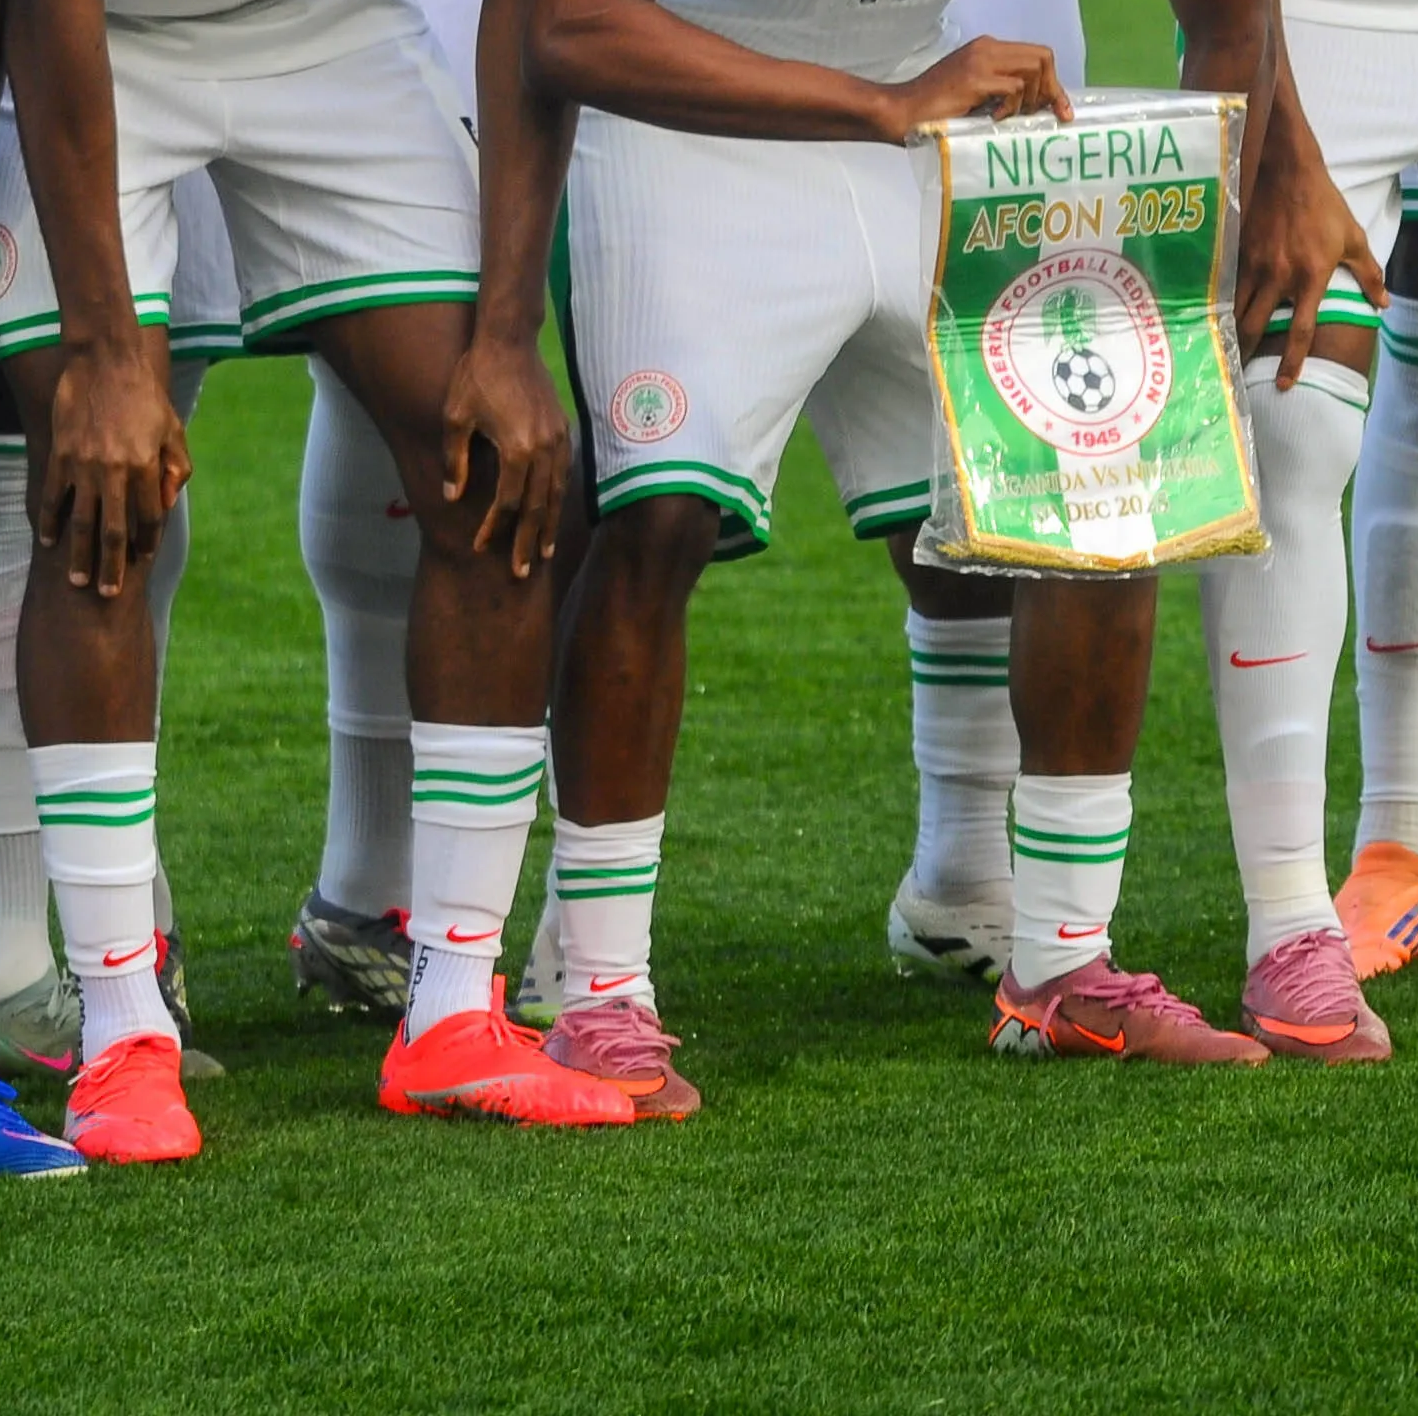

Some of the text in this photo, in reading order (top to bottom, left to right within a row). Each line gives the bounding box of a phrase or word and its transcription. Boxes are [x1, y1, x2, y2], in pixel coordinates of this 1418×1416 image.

[986, 125, 1184, 189] NIGERIA
[963, 184, 1206, 254] AFCON 2025
[989, 258, 1166, 414] NIGERIA FOOTBALL FEDERATION
[1071, 427, 1122, 448] 1945
[1065, 498, 1111, 523] DEC
